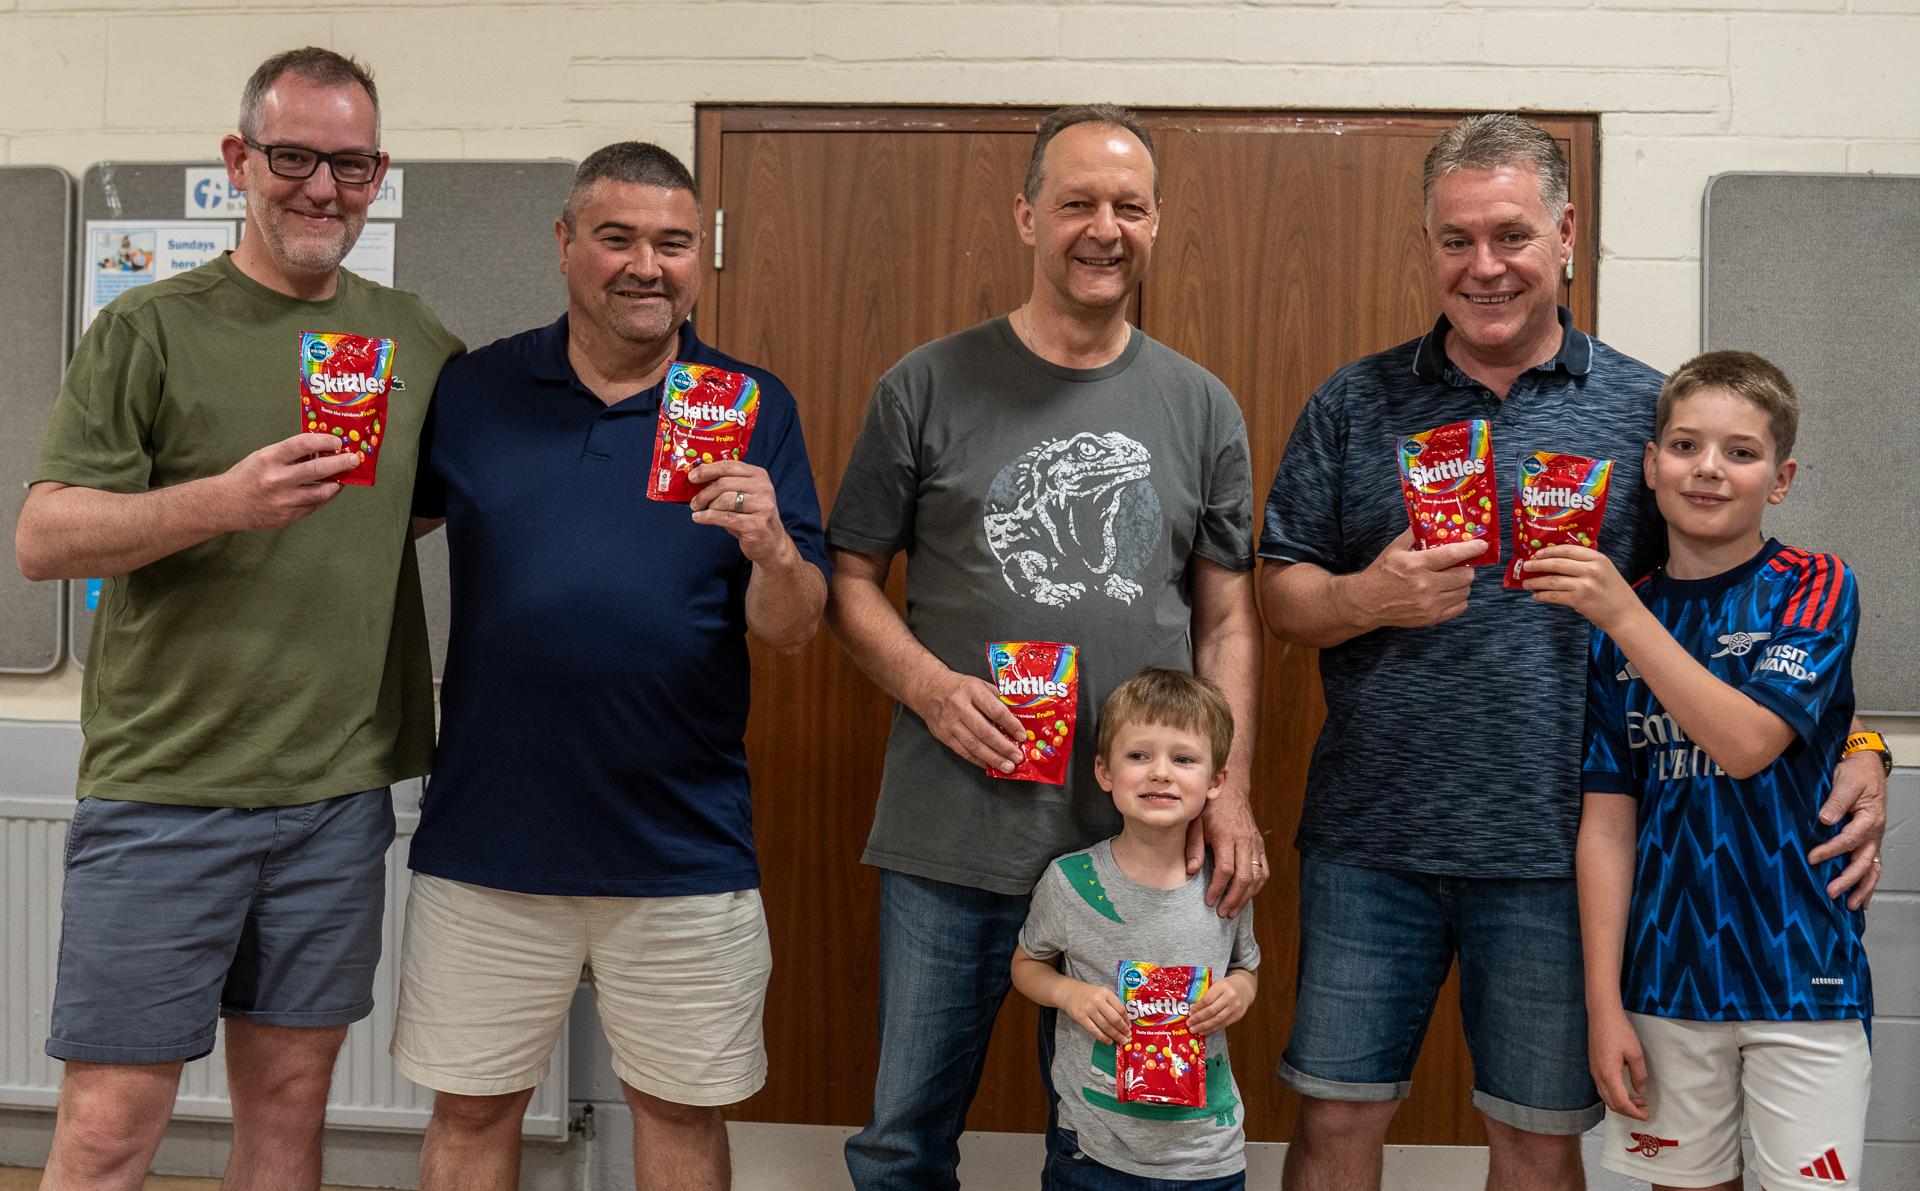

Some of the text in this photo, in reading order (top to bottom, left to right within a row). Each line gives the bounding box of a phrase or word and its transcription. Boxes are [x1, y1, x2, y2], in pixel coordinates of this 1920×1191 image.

[168, 240, 215, 252] Sundays
[171, 260, 196, 269] here
[309, 372, 386, 395] Skittles
[360, 408, 376, 418] Fruits
[668, 400, 747, 427] Skittles
[1408, 457, 1486, 487] Skittles
[1460, 488, 1477, 501] Fruits
[1522, 485, 1596, 511] Skittles
[1558, 523, 1578, 531] Fruits
[1766, 644, 1809, 664] VISIT
[1753, 657, 1817, 685] WANDA
[1036, 710, 1056, 719] Fruits
[1125, 998, 1194, 1021] Skittle
